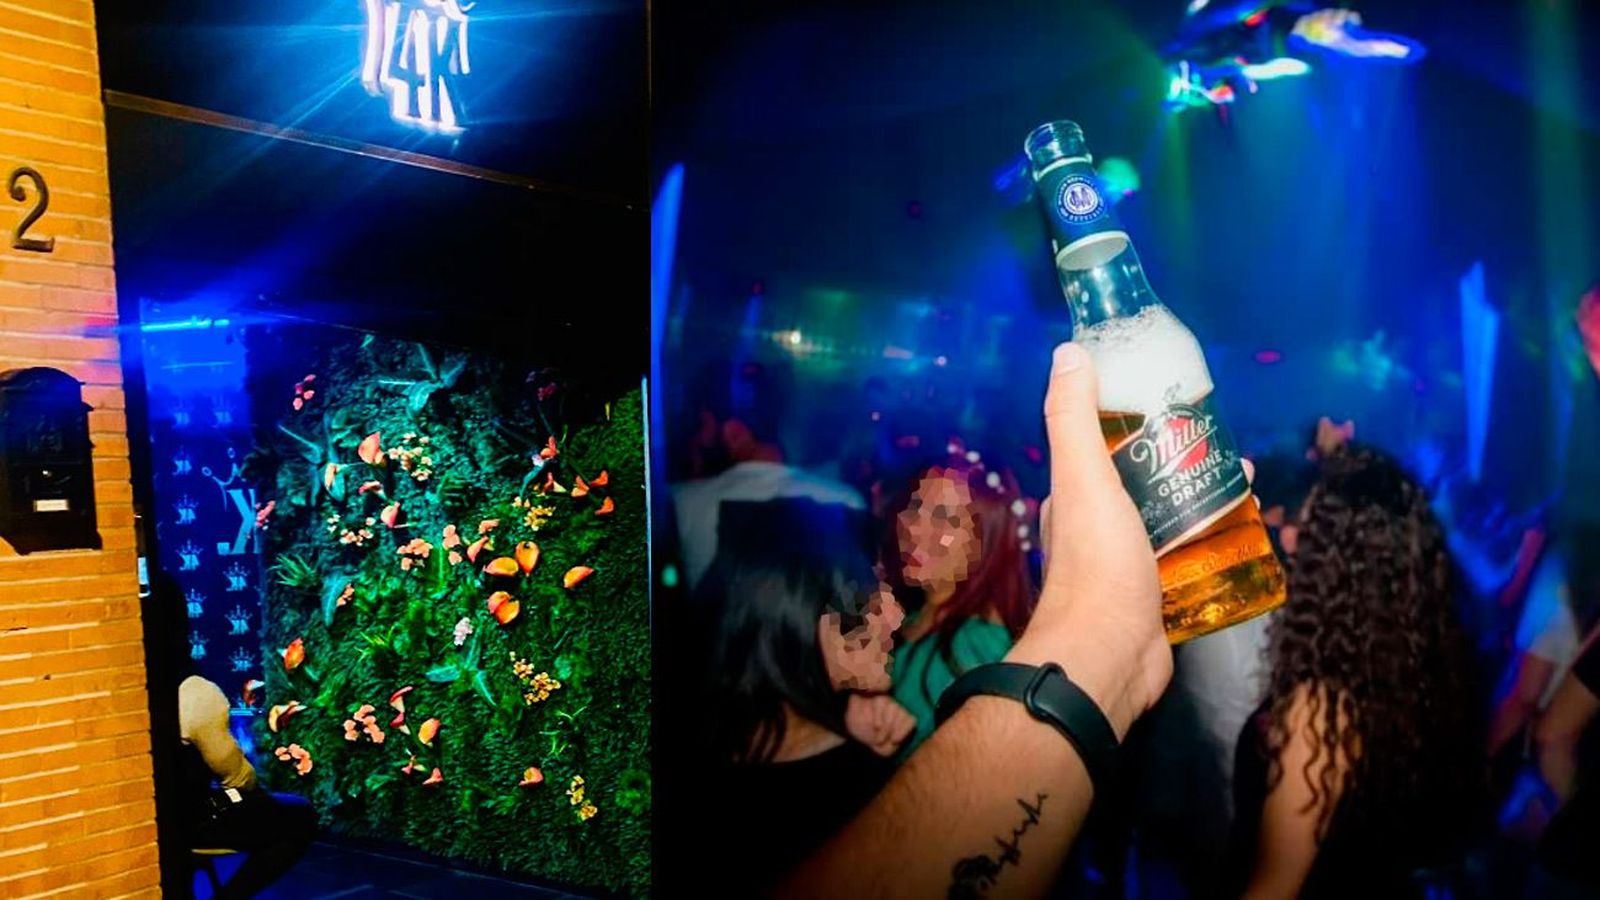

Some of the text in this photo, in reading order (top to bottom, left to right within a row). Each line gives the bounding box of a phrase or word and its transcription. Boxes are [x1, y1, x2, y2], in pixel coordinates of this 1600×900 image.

[7, 167, 54, 252] 2
[1130, 414, 1213, 475] Miller
[1158, 449, 1222, 497] GENUINE
[1171, 467, 1221, 506] DRAFT
